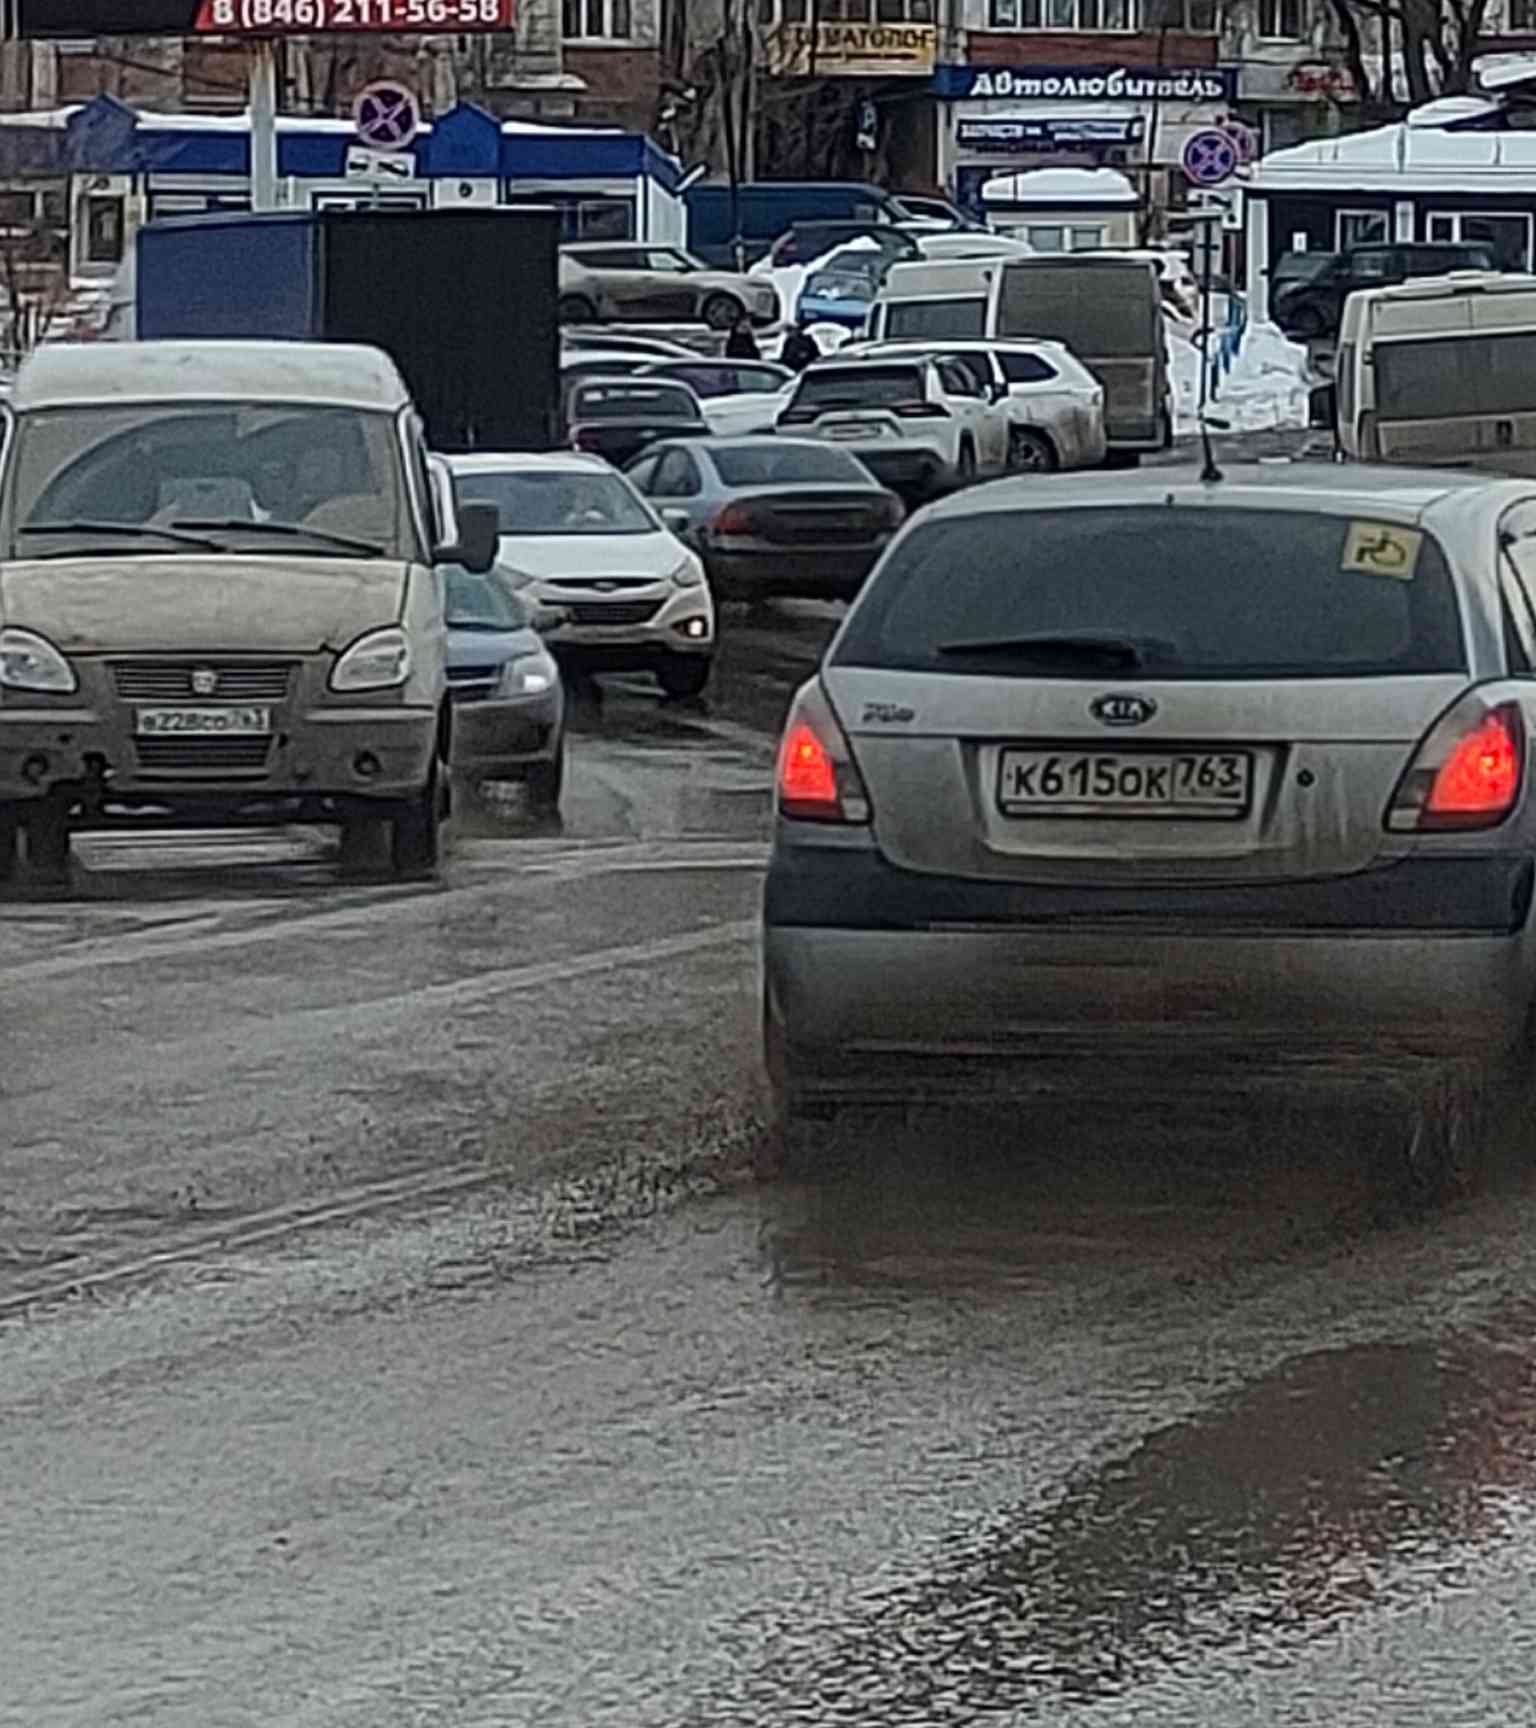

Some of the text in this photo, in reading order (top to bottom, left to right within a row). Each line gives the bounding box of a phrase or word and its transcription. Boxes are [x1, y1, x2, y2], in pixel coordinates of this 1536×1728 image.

[970, 69, 1223, 101] Автолюбитель
[1102, 699, 1143, 719] KIA
[1173, 757, 1240, 787] 763
